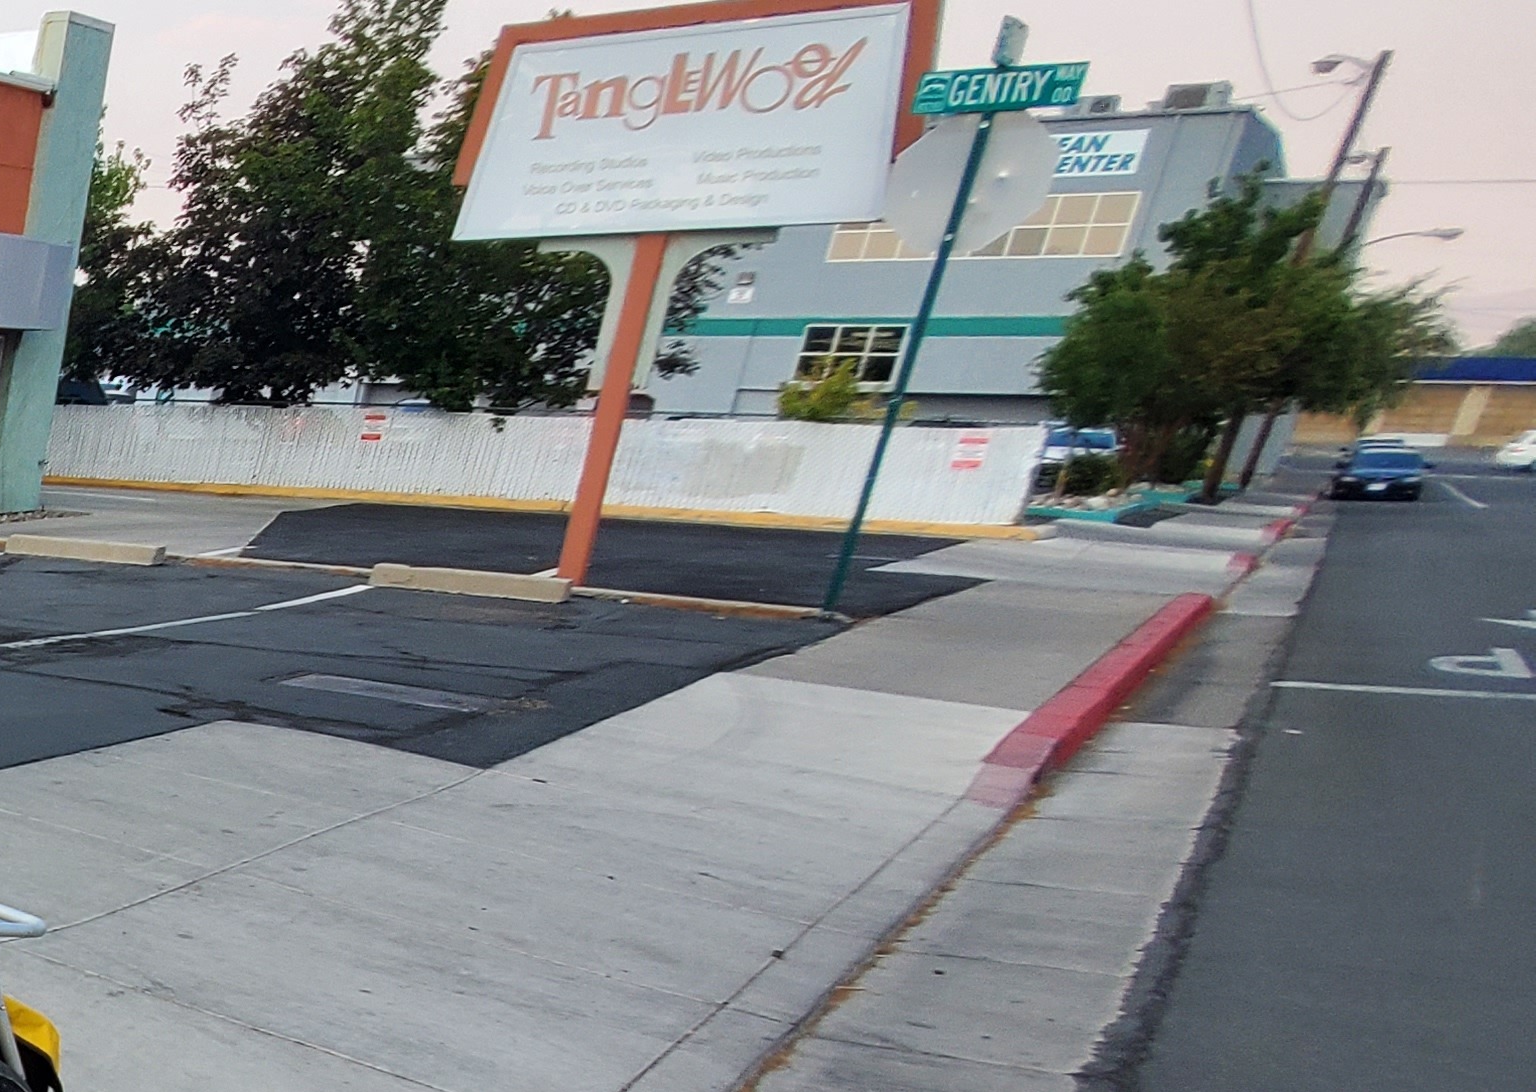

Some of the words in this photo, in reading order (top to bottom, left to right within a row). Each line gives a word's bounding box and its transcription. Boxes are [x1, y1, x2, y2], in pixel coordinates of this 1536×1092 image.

[950, 70, 1055, 106] GENTRY
[693, 150, 734, 163] Video
[736, 145, 822, 159] Productions
[1055, 153, 1136, 173] ENTER
[530, 160, 595, 174] Recording
[696, 172, 737, 185] Music
[741, 168, 820, 182] Production
[559, 181, 593, 194] Over
[596, 179, 654, 192] Services
[556, 201, 577, 214] CD
[594, 199, 626, 213] DVD
[631, 196, 700, 211] Packaging
